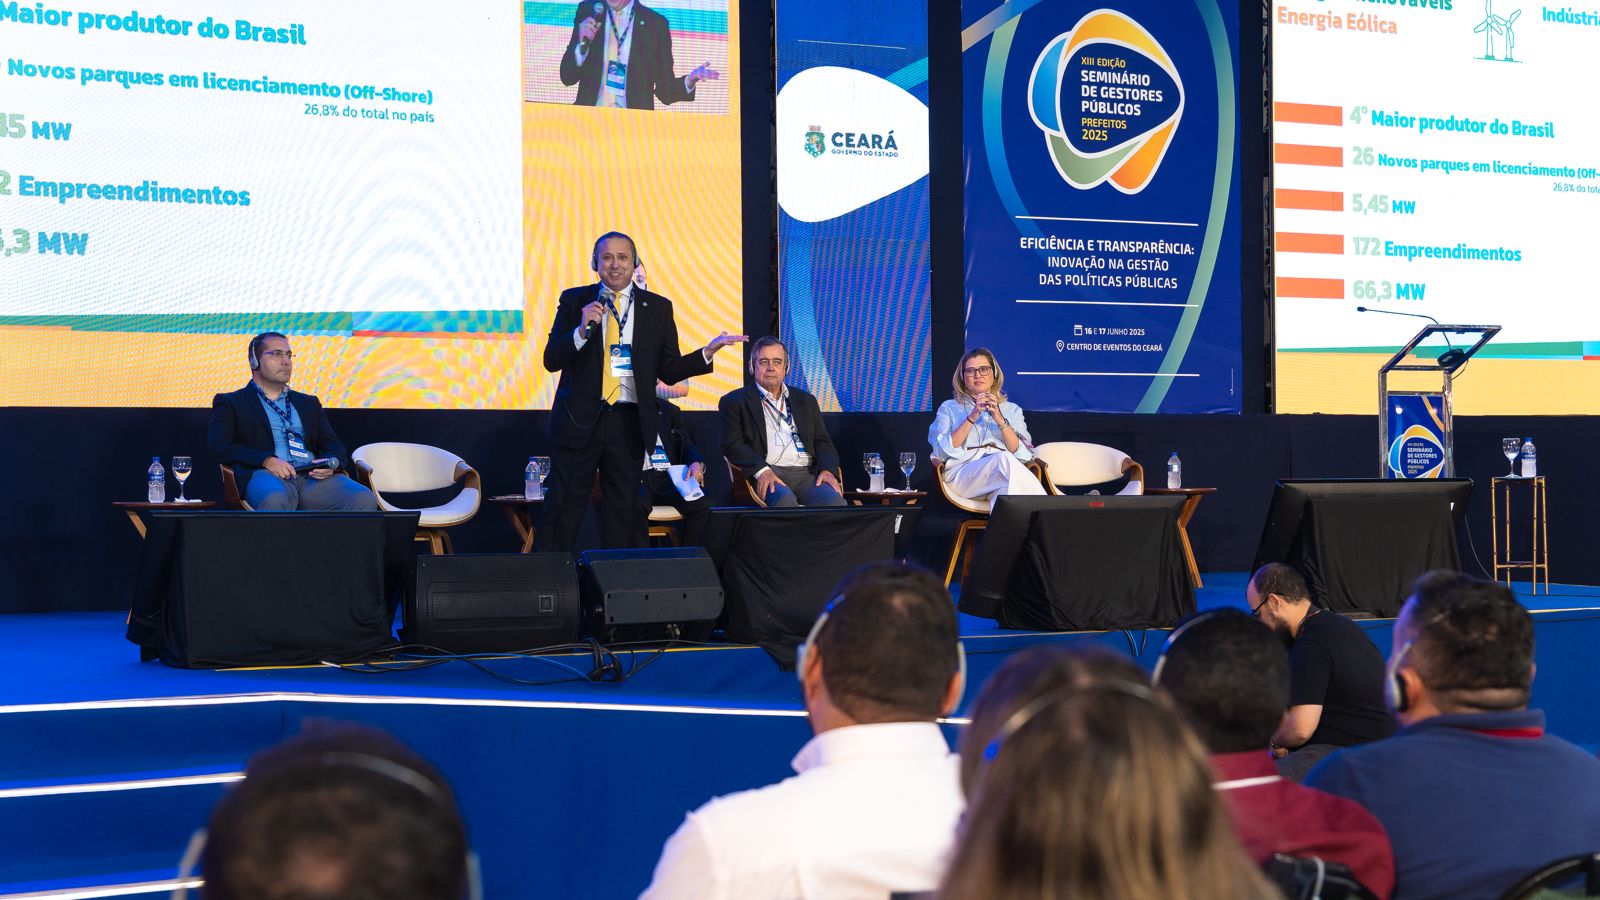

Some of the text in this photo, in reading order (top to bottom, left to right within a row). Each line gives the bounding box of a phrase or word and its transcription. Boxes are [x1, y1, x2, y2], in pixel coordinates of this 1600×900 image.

[0, 0, 306, 46] Maior produtor do Brasil
[1277, 6, 1398, 34] Energia Eólica
[1542, 6, 1600, 26] Indústri
[1081, 56, 1126, 69] XIII EDIÇÃO
[8, 58, 433, 105] Novos parques em licenciamento (Off-Shore)
[1081, 69, 1150, 86] SEMINÁRIO
[1081, 85, 1163, 103] DE GESTORES
[304, 103, 435, 124] 26,8% do total no país
[1081, 100, 1141, 116] PÚBLICOS
[31, 120, 72, 141] MW
[1081, 118, 1127, 130] PREFEITOS
[1371, 110, 1416, 128] Maior
[1419, 115, 1486, 133] produtor
[1489, 119, 1509, 135] do
[1512, 120, 1555, 138] Brasil
[831, 130, 898, 150] CEARÁ
[1082, 129, 1108, 141] 2025
[1352, 146, 1375, 166] 26
[1378, 153, 1418, 169] Novos
[1420, 158, 1470, 174] parques
[1472, 162, 1490, 173] em
[1493, 160, 1576, 178] licenciamento
[19, 175, 250, 206] Empreendimentos
[1553, 182, 1575, 193] 26,8%
[1576, 184, 1586, 193] do
[1352, 192, 1416, 215] 5,45 MW
[38, 231, 89, 256] MW
[1020, 235, 1195, 255] EFICIÊNCIA E TRANSPARÊNCIA:
[1352, 236, 1522, 262] 172 Empreendimentos
[1047, 255, 1169, 272] INOVAÇÃO NA GESTÃO
[1039, 272, 1178, 289] DAS POLÍTICAS PÚBLICAS
[1353, 279, 1426, 302] 66,3 MW
[1085, 327, 1093, 335] 16
[1099, 327, 1106, 335] 17
[1107, 328, 1128, 336] JUNHO
[1129, 328, 1146, 336] 2025
[1066, 342, 1163, 352] CENTRO DE EVENTOS DO CEARÁ
